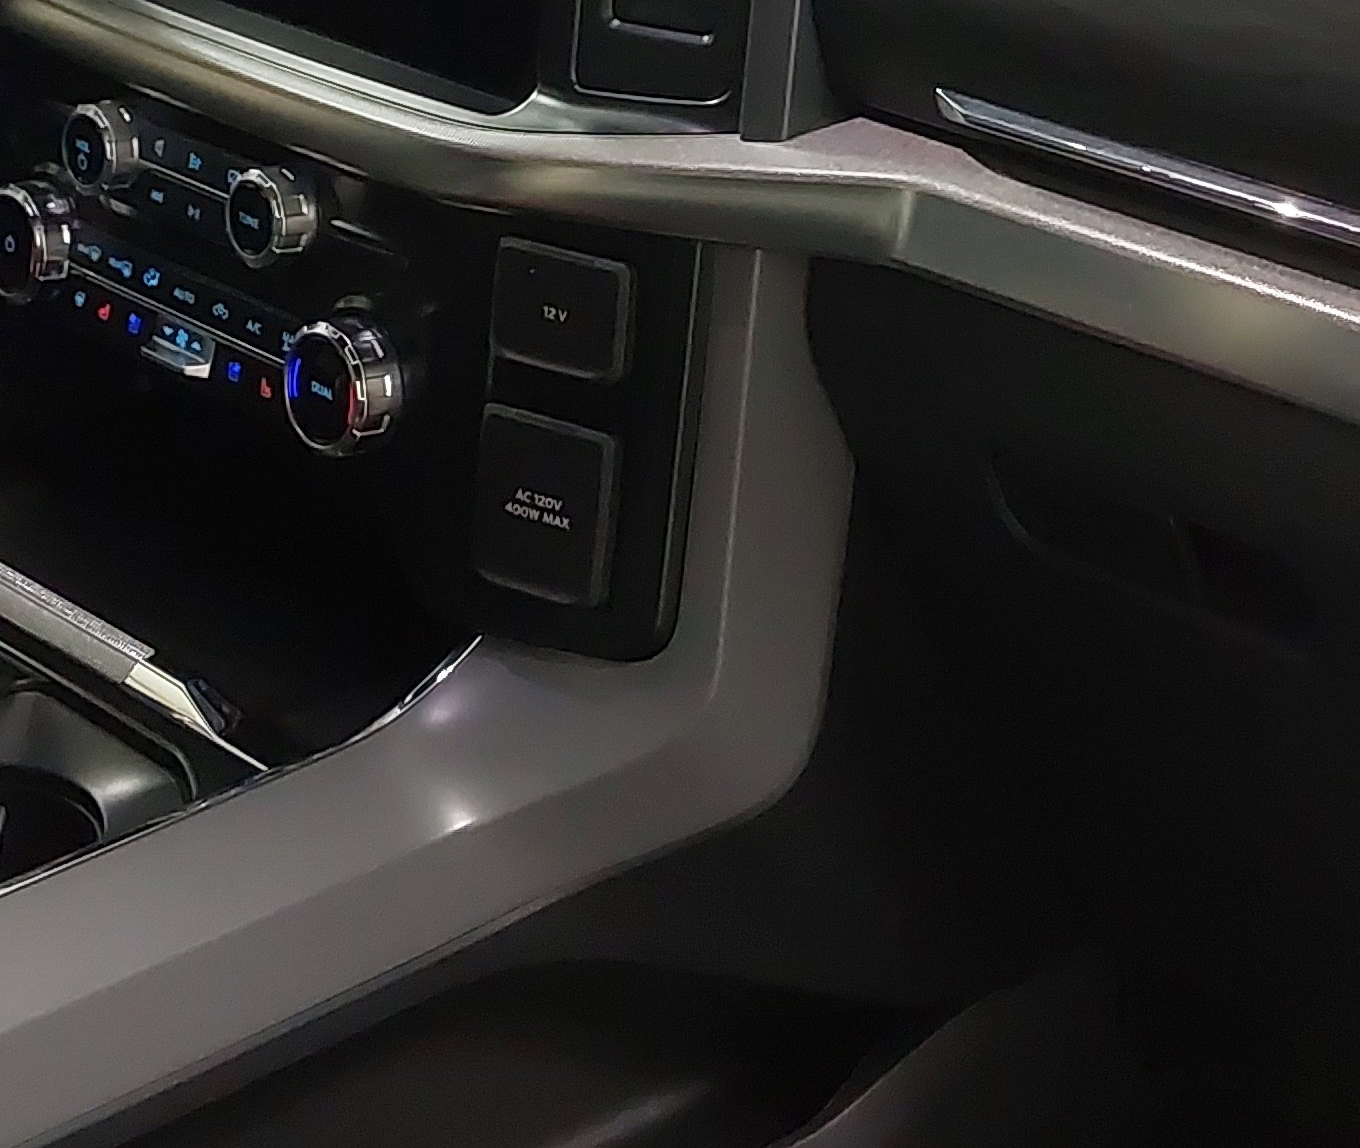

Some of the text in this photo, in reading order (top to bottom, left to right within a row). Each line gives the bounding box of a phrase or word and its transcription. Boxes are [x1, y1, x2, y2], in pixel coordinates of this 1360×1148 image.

[515, 487, 563, 511] AC 120V
[505, 502, 570, 531] 400W MAX
